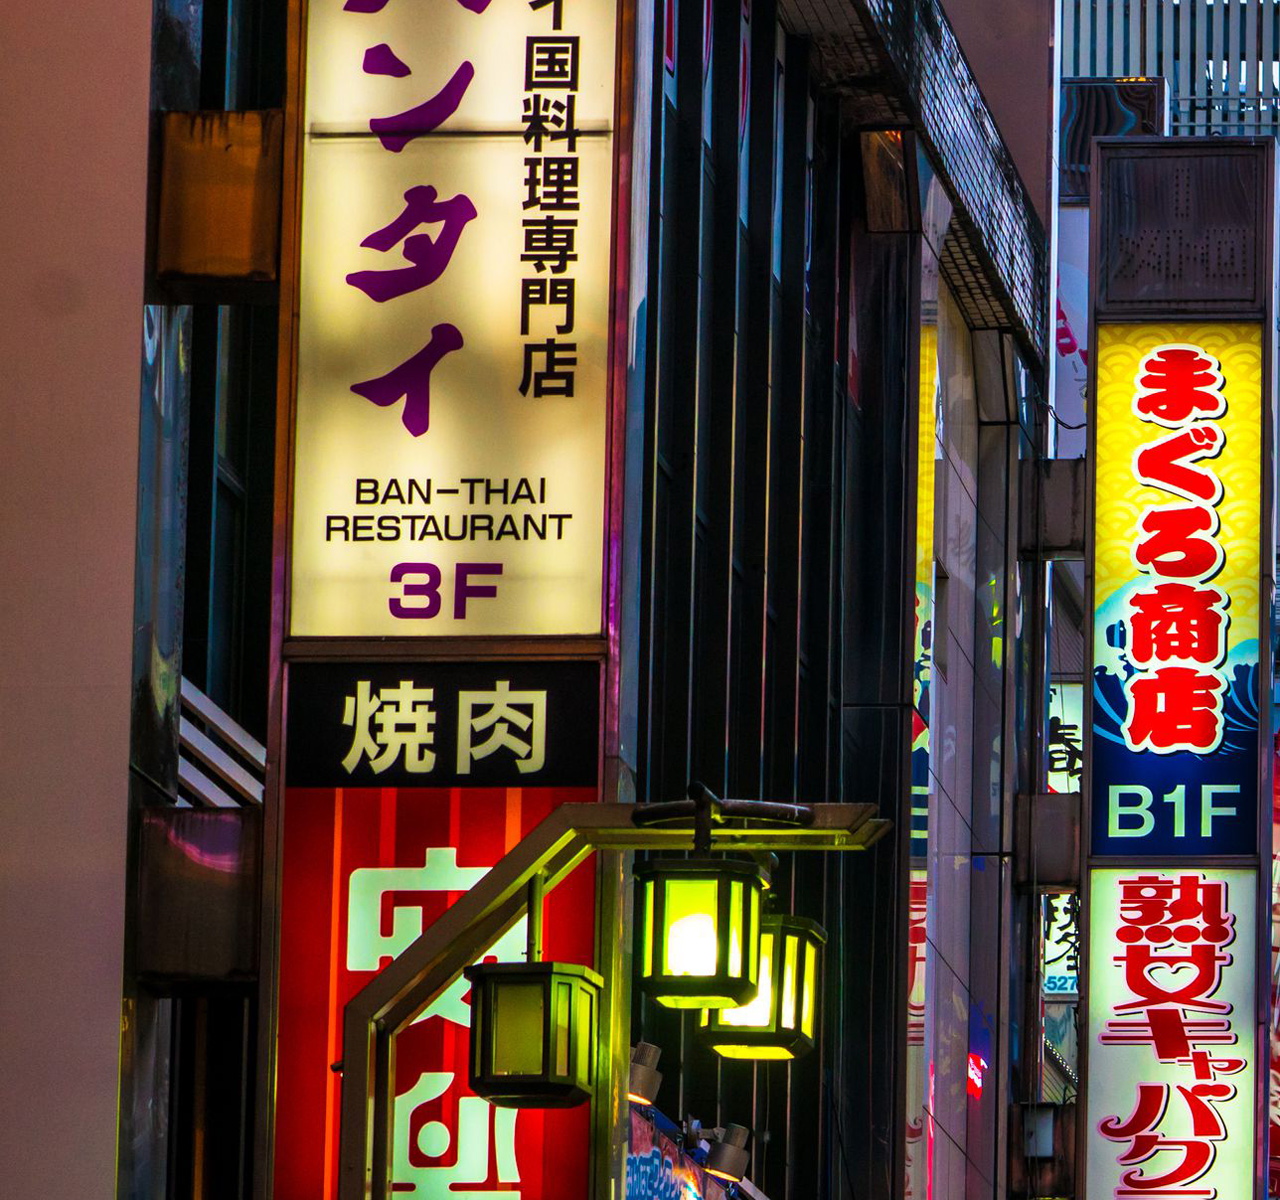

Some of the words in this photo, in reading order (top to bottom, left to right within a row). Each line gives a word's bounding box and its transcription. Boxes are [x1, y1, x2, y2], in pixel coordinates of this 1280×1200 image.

[345, 0, 478, 437] ンタイ
[355, 478, 547, 505] BAN-THAI
[325, 514, 573, 542] RESTAURANT
[1129, 346, 1224, 753] まぐろ商店
[388, 562, 504, 620] 3F
[341, 680, 548, 776] 焼肉
[1107, 782, 1241, 839] B1F
